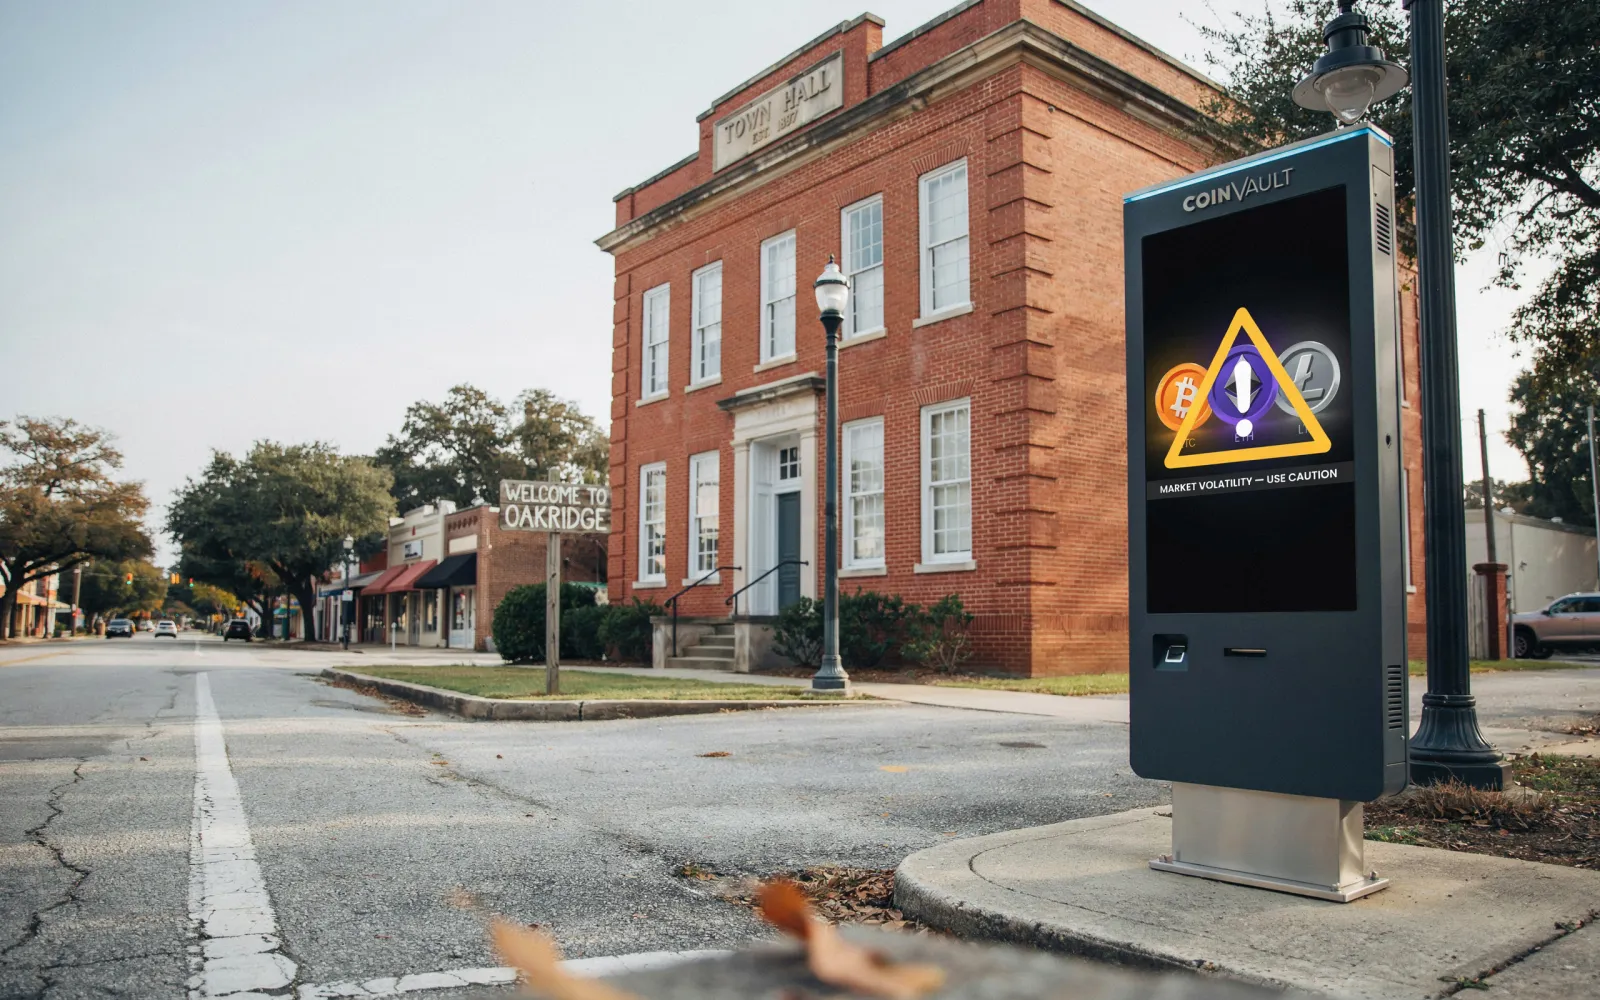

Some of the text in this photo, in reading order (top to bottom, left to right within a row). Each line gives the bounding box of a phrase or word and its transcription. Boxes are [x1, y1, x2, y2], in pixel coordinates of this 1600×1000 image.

[724, 70, 831, 144] TOWN HALL
[504, 483, 608, 505] WELCOME TO
[1160, 482, 1197, 494] MARKET
[1199, 477, 1253, 490] VOLATILITY
[1266, 473, 1286, 484] USE
[1288, 468, 1338, 482] CAUTION
[504, 504, 608, 531] OAKRIDGE
